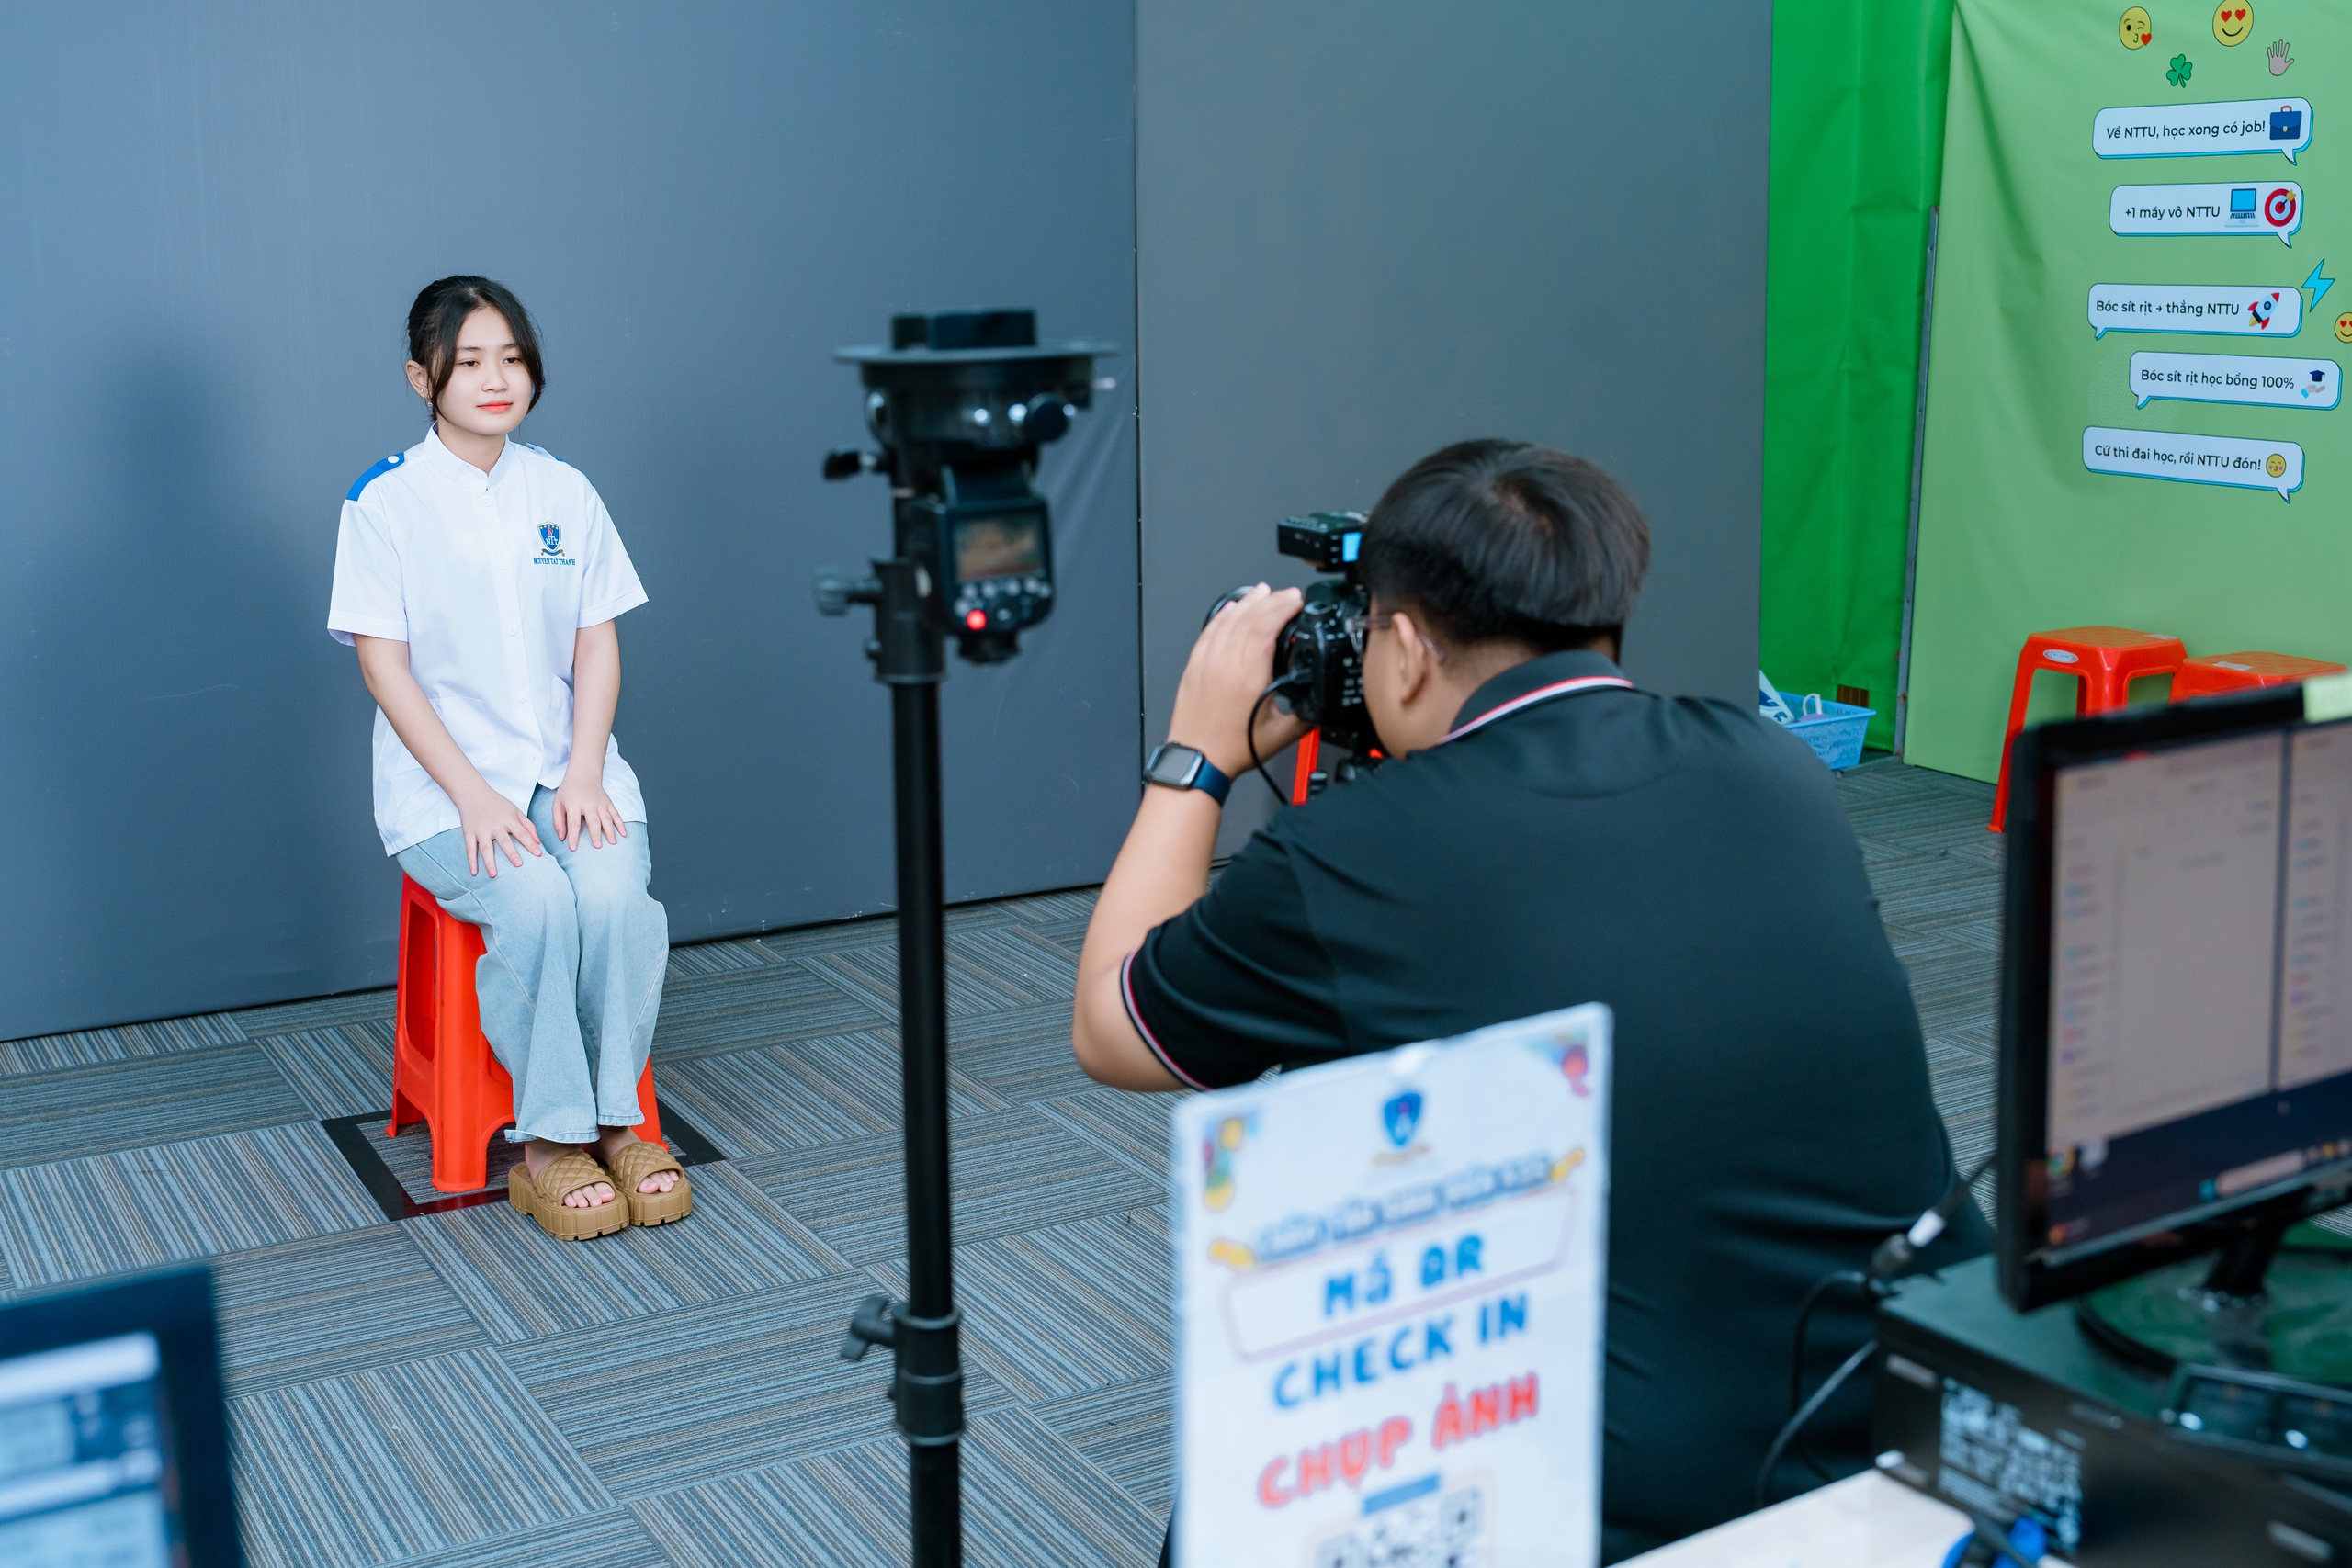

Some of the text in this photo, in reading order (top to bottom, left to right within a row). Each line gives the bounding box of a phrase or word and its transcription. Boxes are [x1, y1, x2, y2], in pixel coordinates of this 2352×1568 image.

[2106, 120, 2266, 139] Về NTTU, học xong có job!
[2125, 206, 2221, 220] +1 máy vô NTTU
[2096, 300, 2240, 316] Bóc sít rịt thẳng NTTU
[2141, 369, 2294, 389] Bóc sít rịt học bổng 100%
[2095, 445, 2261, 470] Cứ thi đại học, rồi NTTU đón!
[1272, 1292, 1529, 1410] CHECK IN
